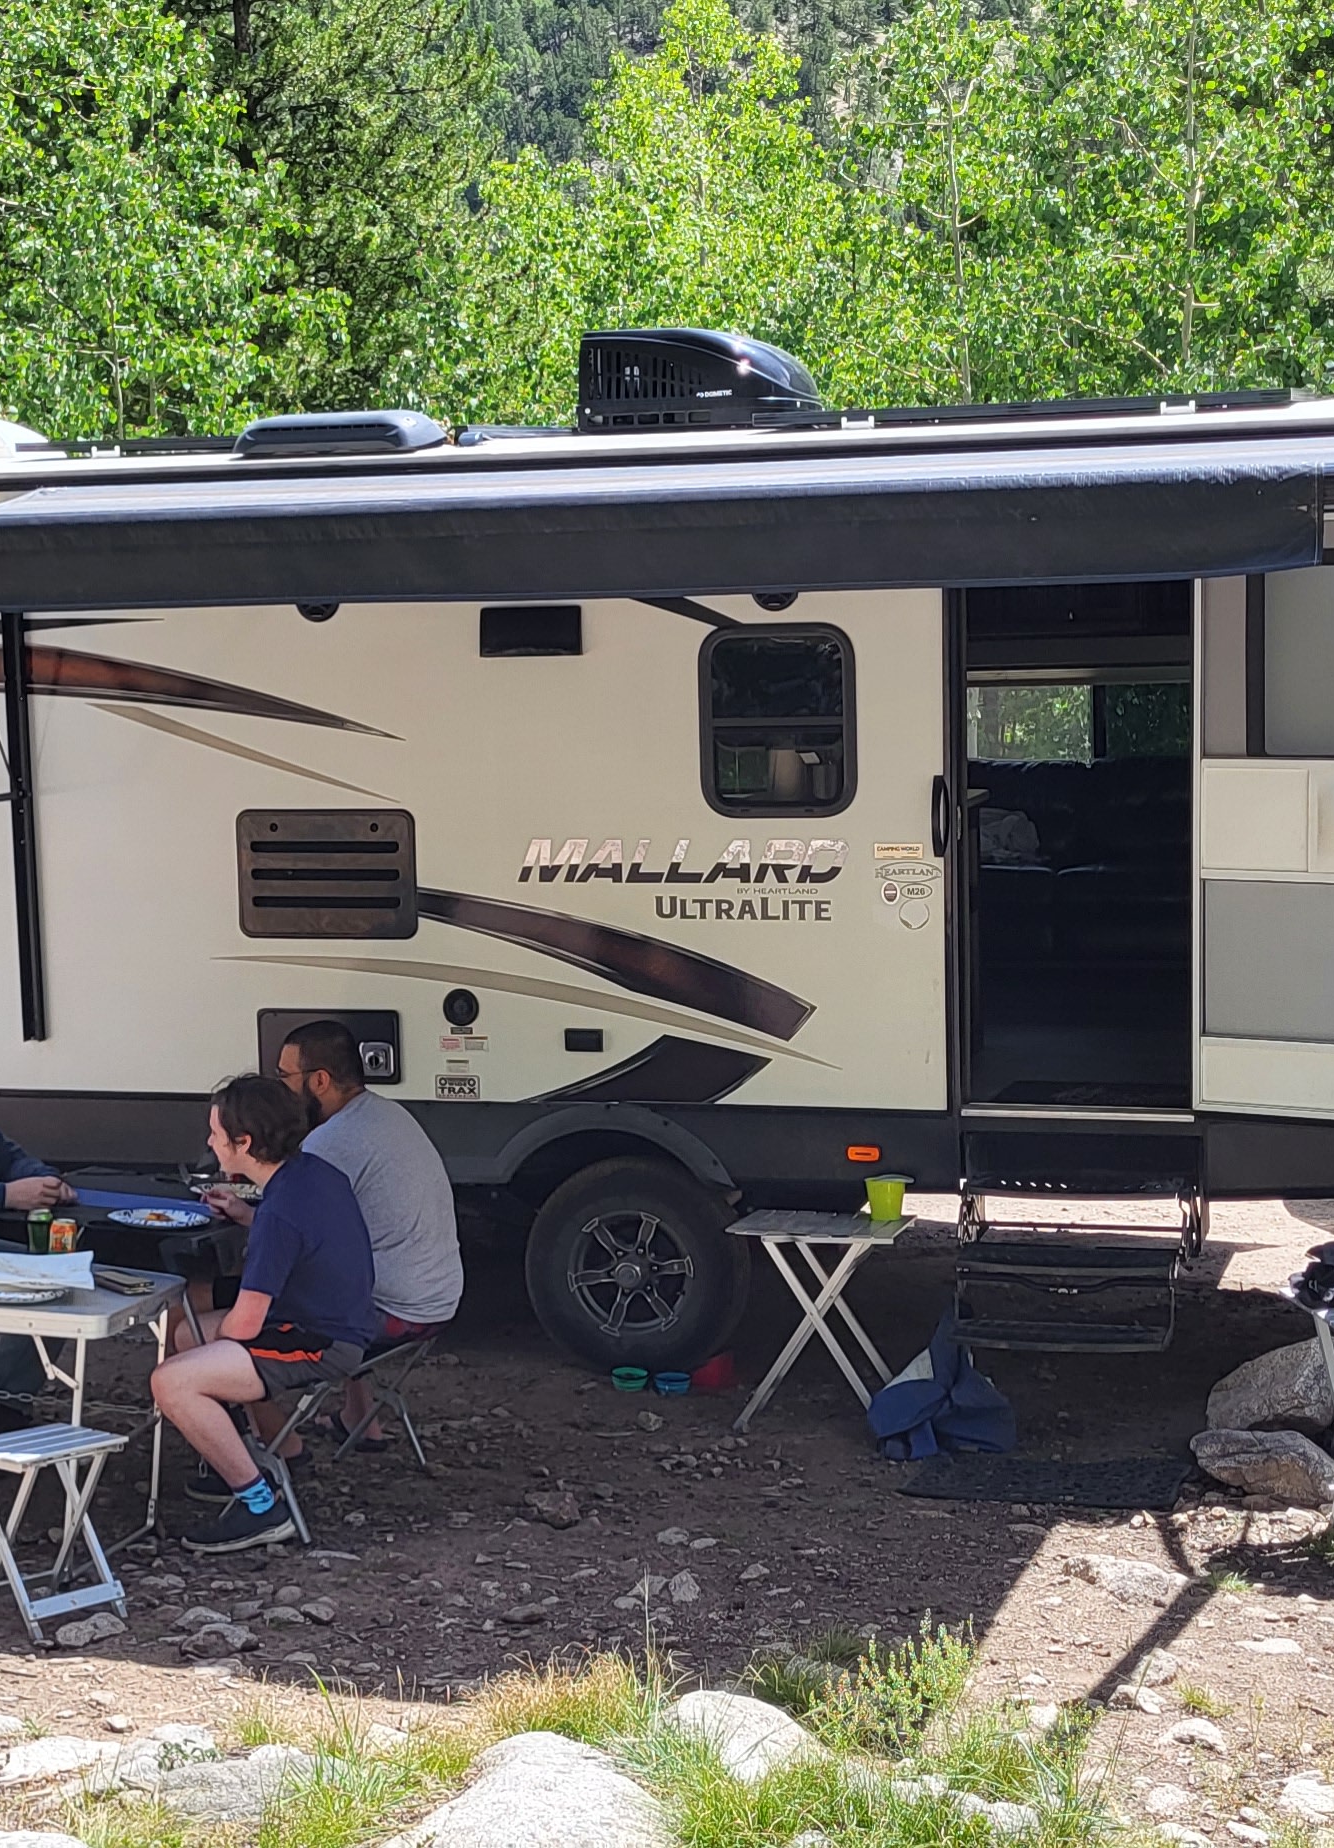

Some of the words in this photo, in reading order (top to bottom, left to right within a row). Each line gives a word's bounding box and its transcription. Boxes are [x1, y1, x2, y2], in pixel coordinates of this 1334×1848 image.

[518, 838, 850, 883] MALLARD
[736, 887, 749, 895] BY
[753, 887, 819, 895] HEARTLAND
[906, 887, 926, 896] M26
[438, 1087, 476, 1095] TRAX
